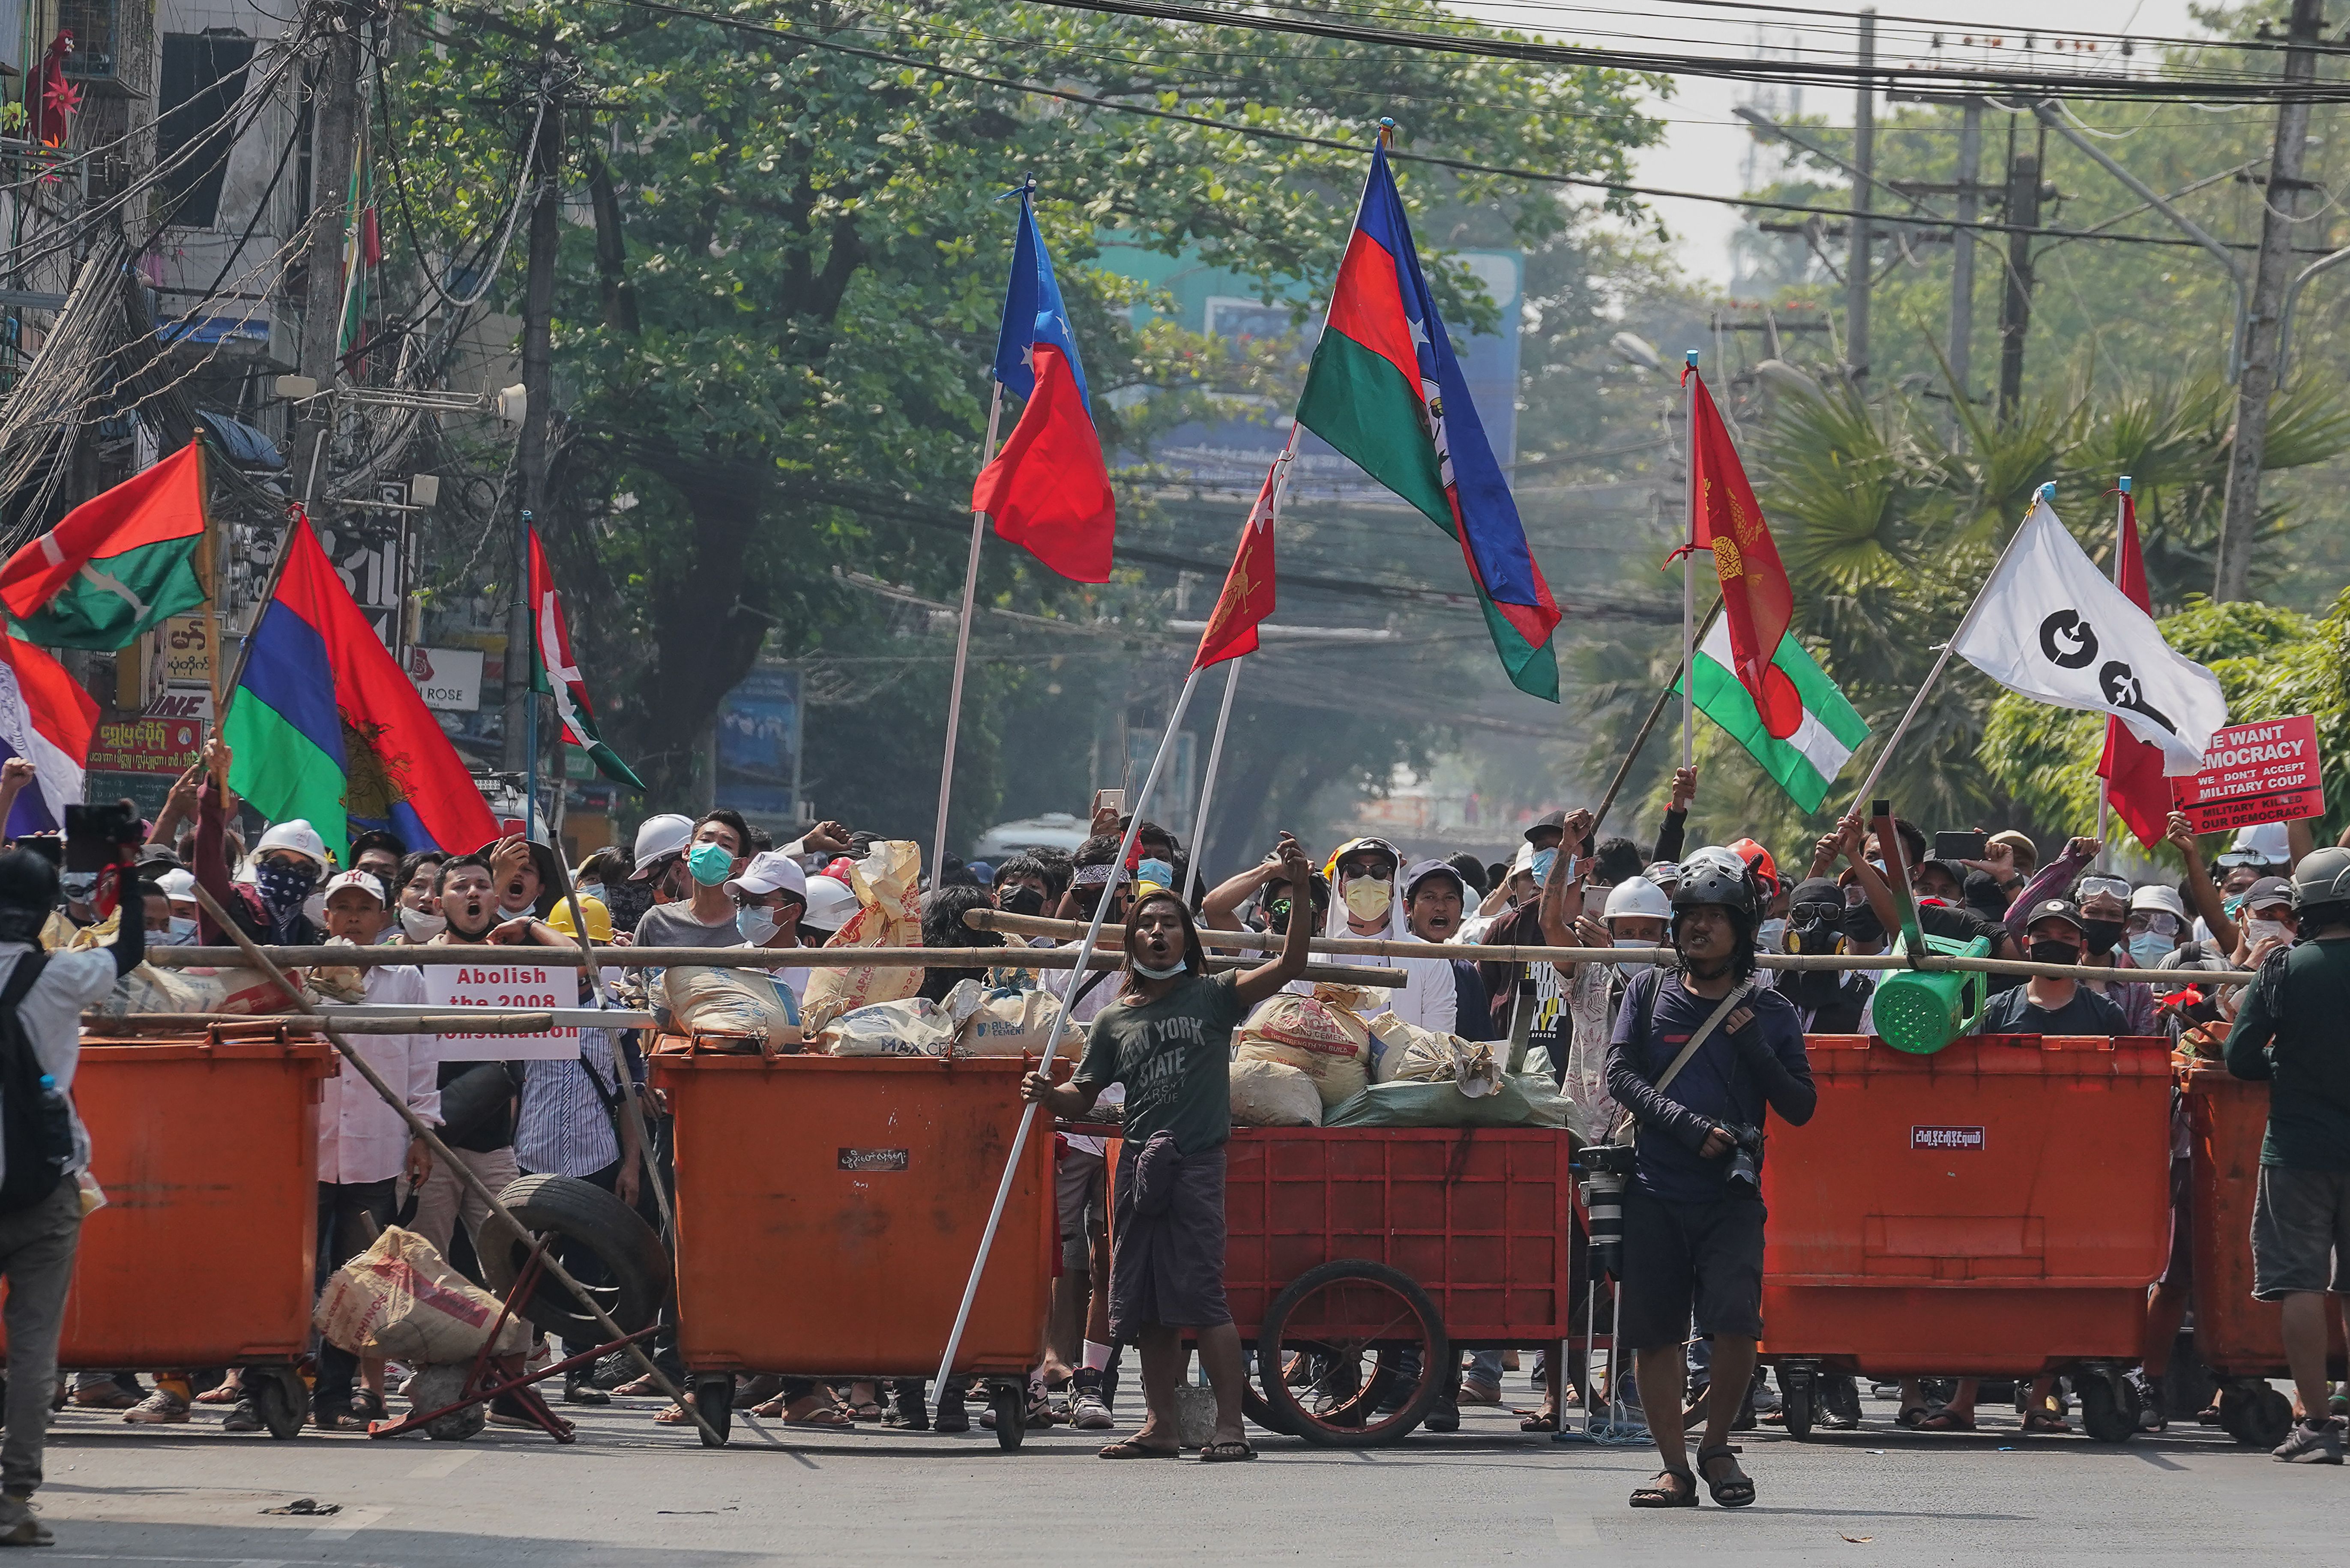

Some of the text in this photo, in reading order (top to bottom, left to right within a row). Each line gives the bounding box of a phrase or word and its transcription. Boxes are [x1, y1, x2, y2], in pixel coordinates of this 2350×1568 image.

[427, 688, 462, 700] ROSE
[2229, 725, 2284, 746] WANT
[2201, 739, 2305, 771] MOCRACY
[2198, 762, 2305, 786] WE DON'T ACCEPT
[2200, 774, 2306, 799] MILITARY COUP
[2202, 796, 2302, 817] MILITARY KILLED
[2202, 805, 2309, 829] OUR DEMOCRACY
[457, 967, 547, 984] Abolish
[449, 994, 556, 1007] the 2008
[991, 1021, 1025, 1029] ALPA
[1154, 1016, 1206, 1047] YORK
[881, 1037, 922, 1055] MAX
[1270, 1032, 1282, 1041] THE
[1281, 1037, 1317, 1050] STRENGTH
[1329, 1045, 1348, 1053] BUILD
[1137, 1046, 1186, 1088] STATE
[1275, 1056, 1287, 1065] NET
